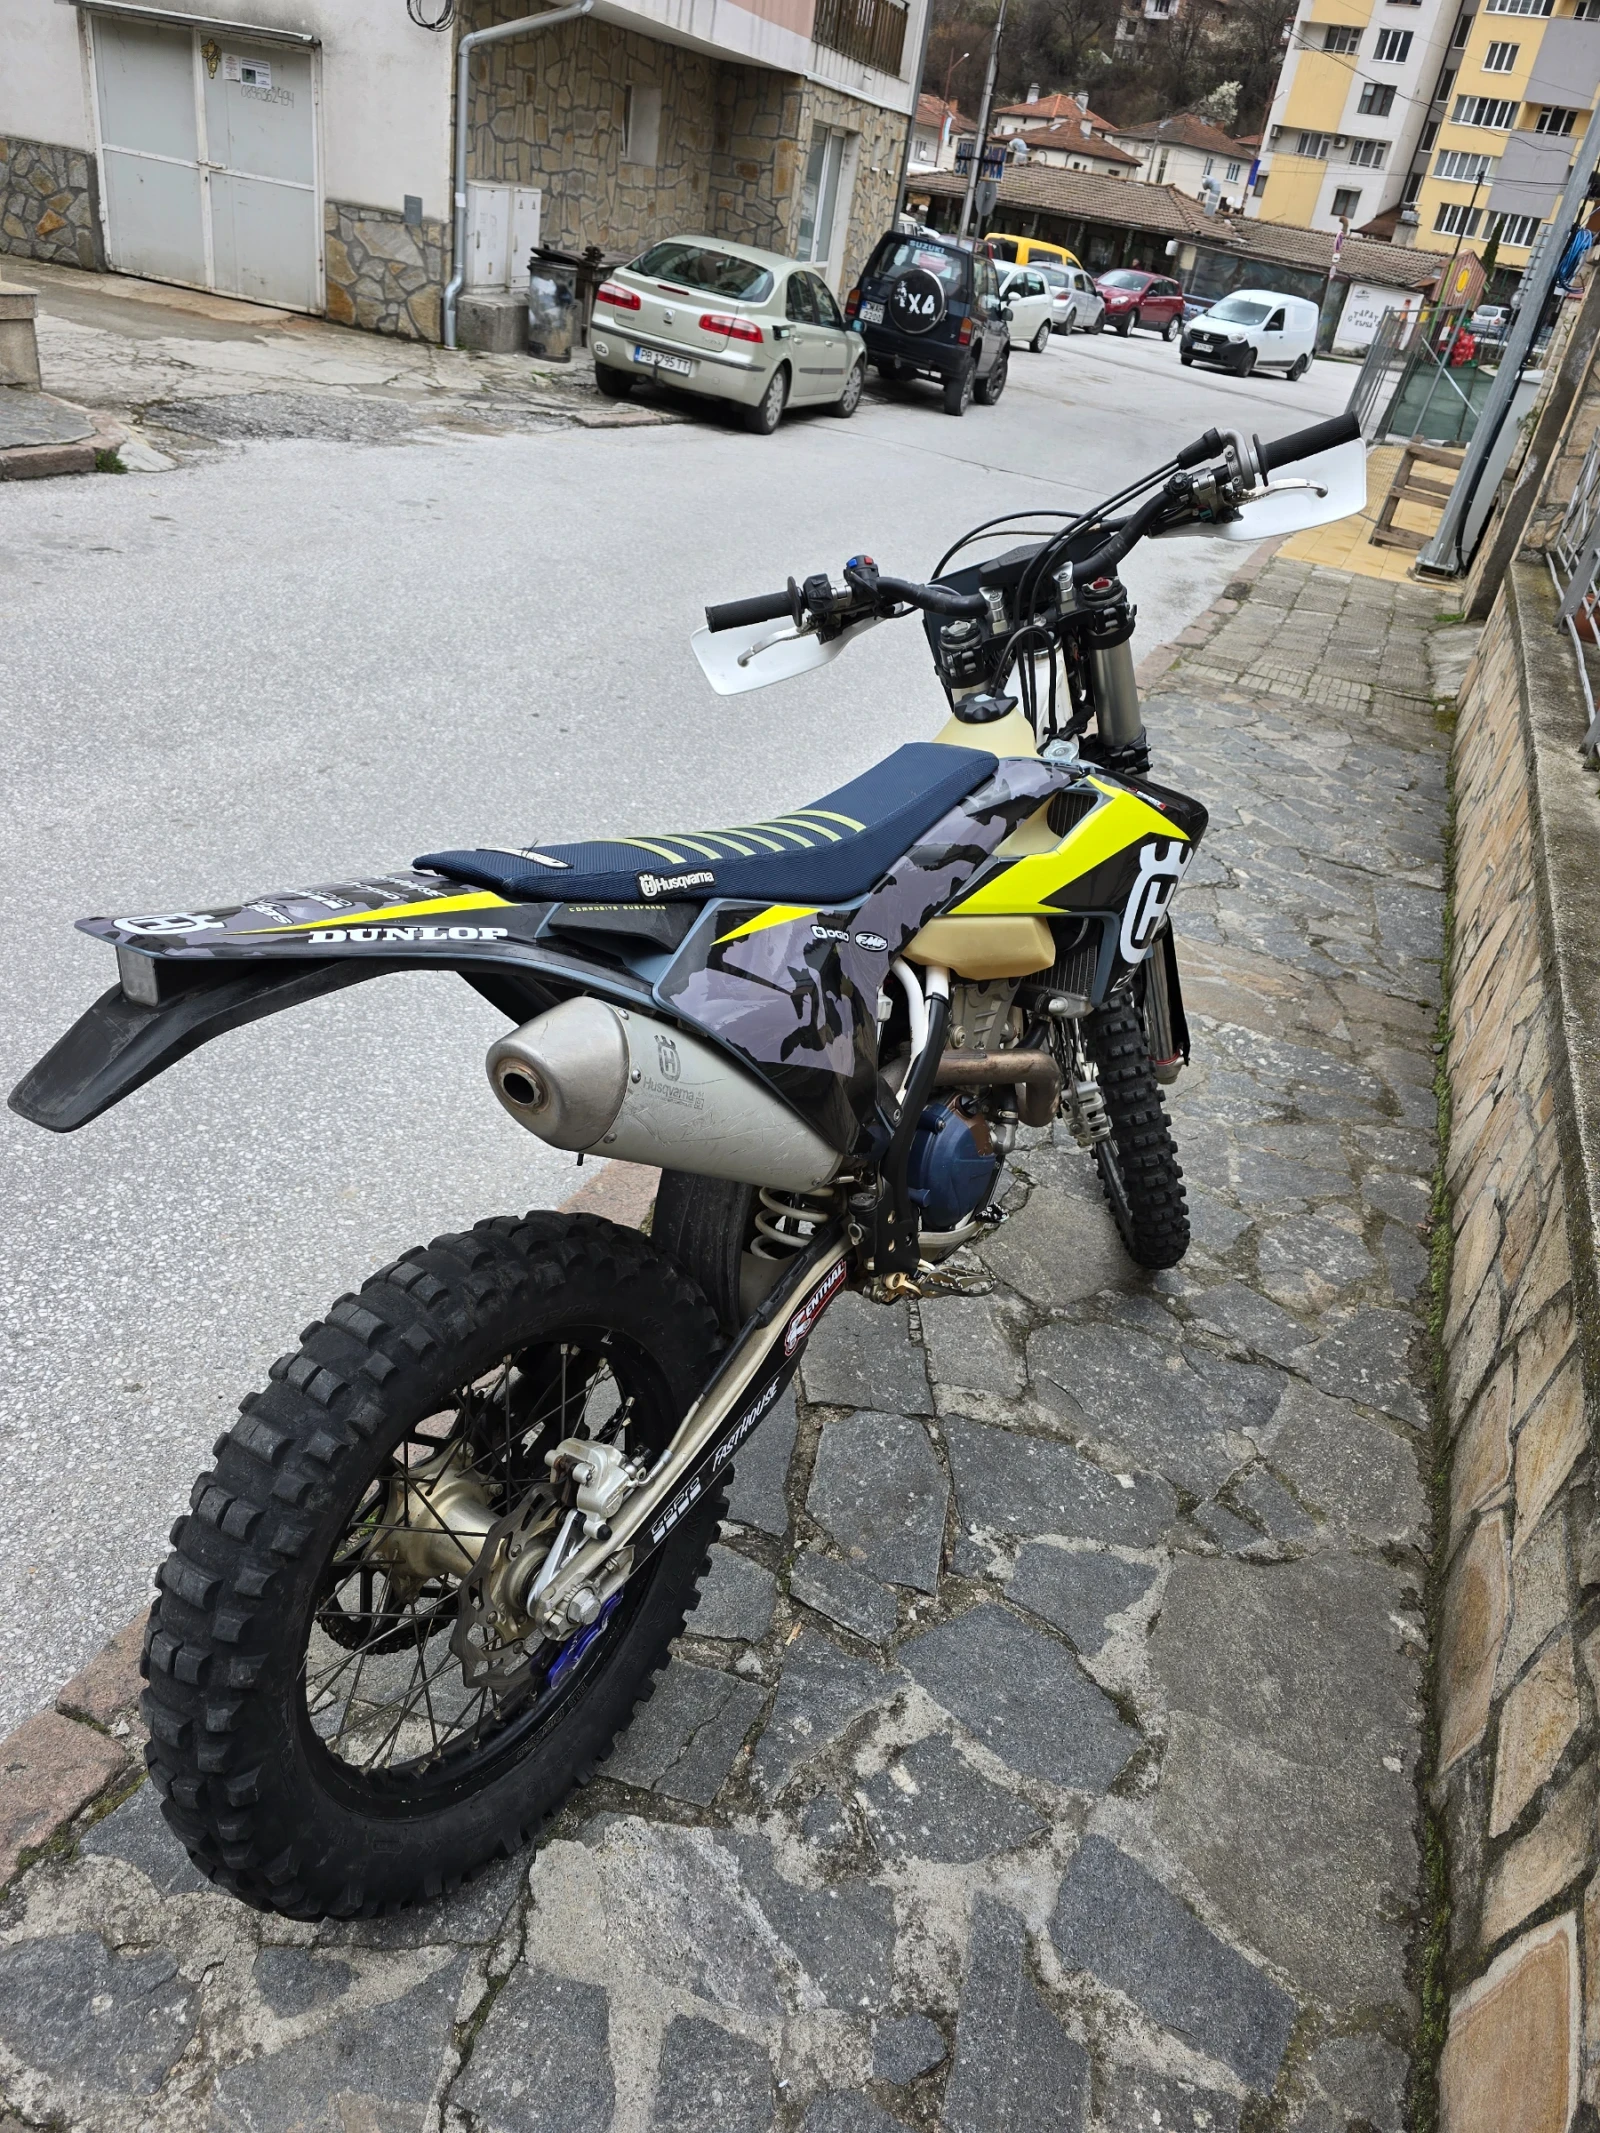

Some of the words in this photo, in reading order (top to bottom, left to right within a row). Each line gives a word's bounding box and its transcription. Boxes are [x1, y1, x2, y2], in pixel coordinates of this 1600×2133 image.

[909, 240, 945, 254] SUZUKI
[640, 349, 651, 362] PB
[656, 871, 715, 892] Husqvarna
[308, 926, 508, 944] DUNLOP
[642, 1076, 695, 1101] Husqvarna
[712, 1376, 780, 1472] FASTHOUSE
[651, 1476, 701, 1536] GoPro
